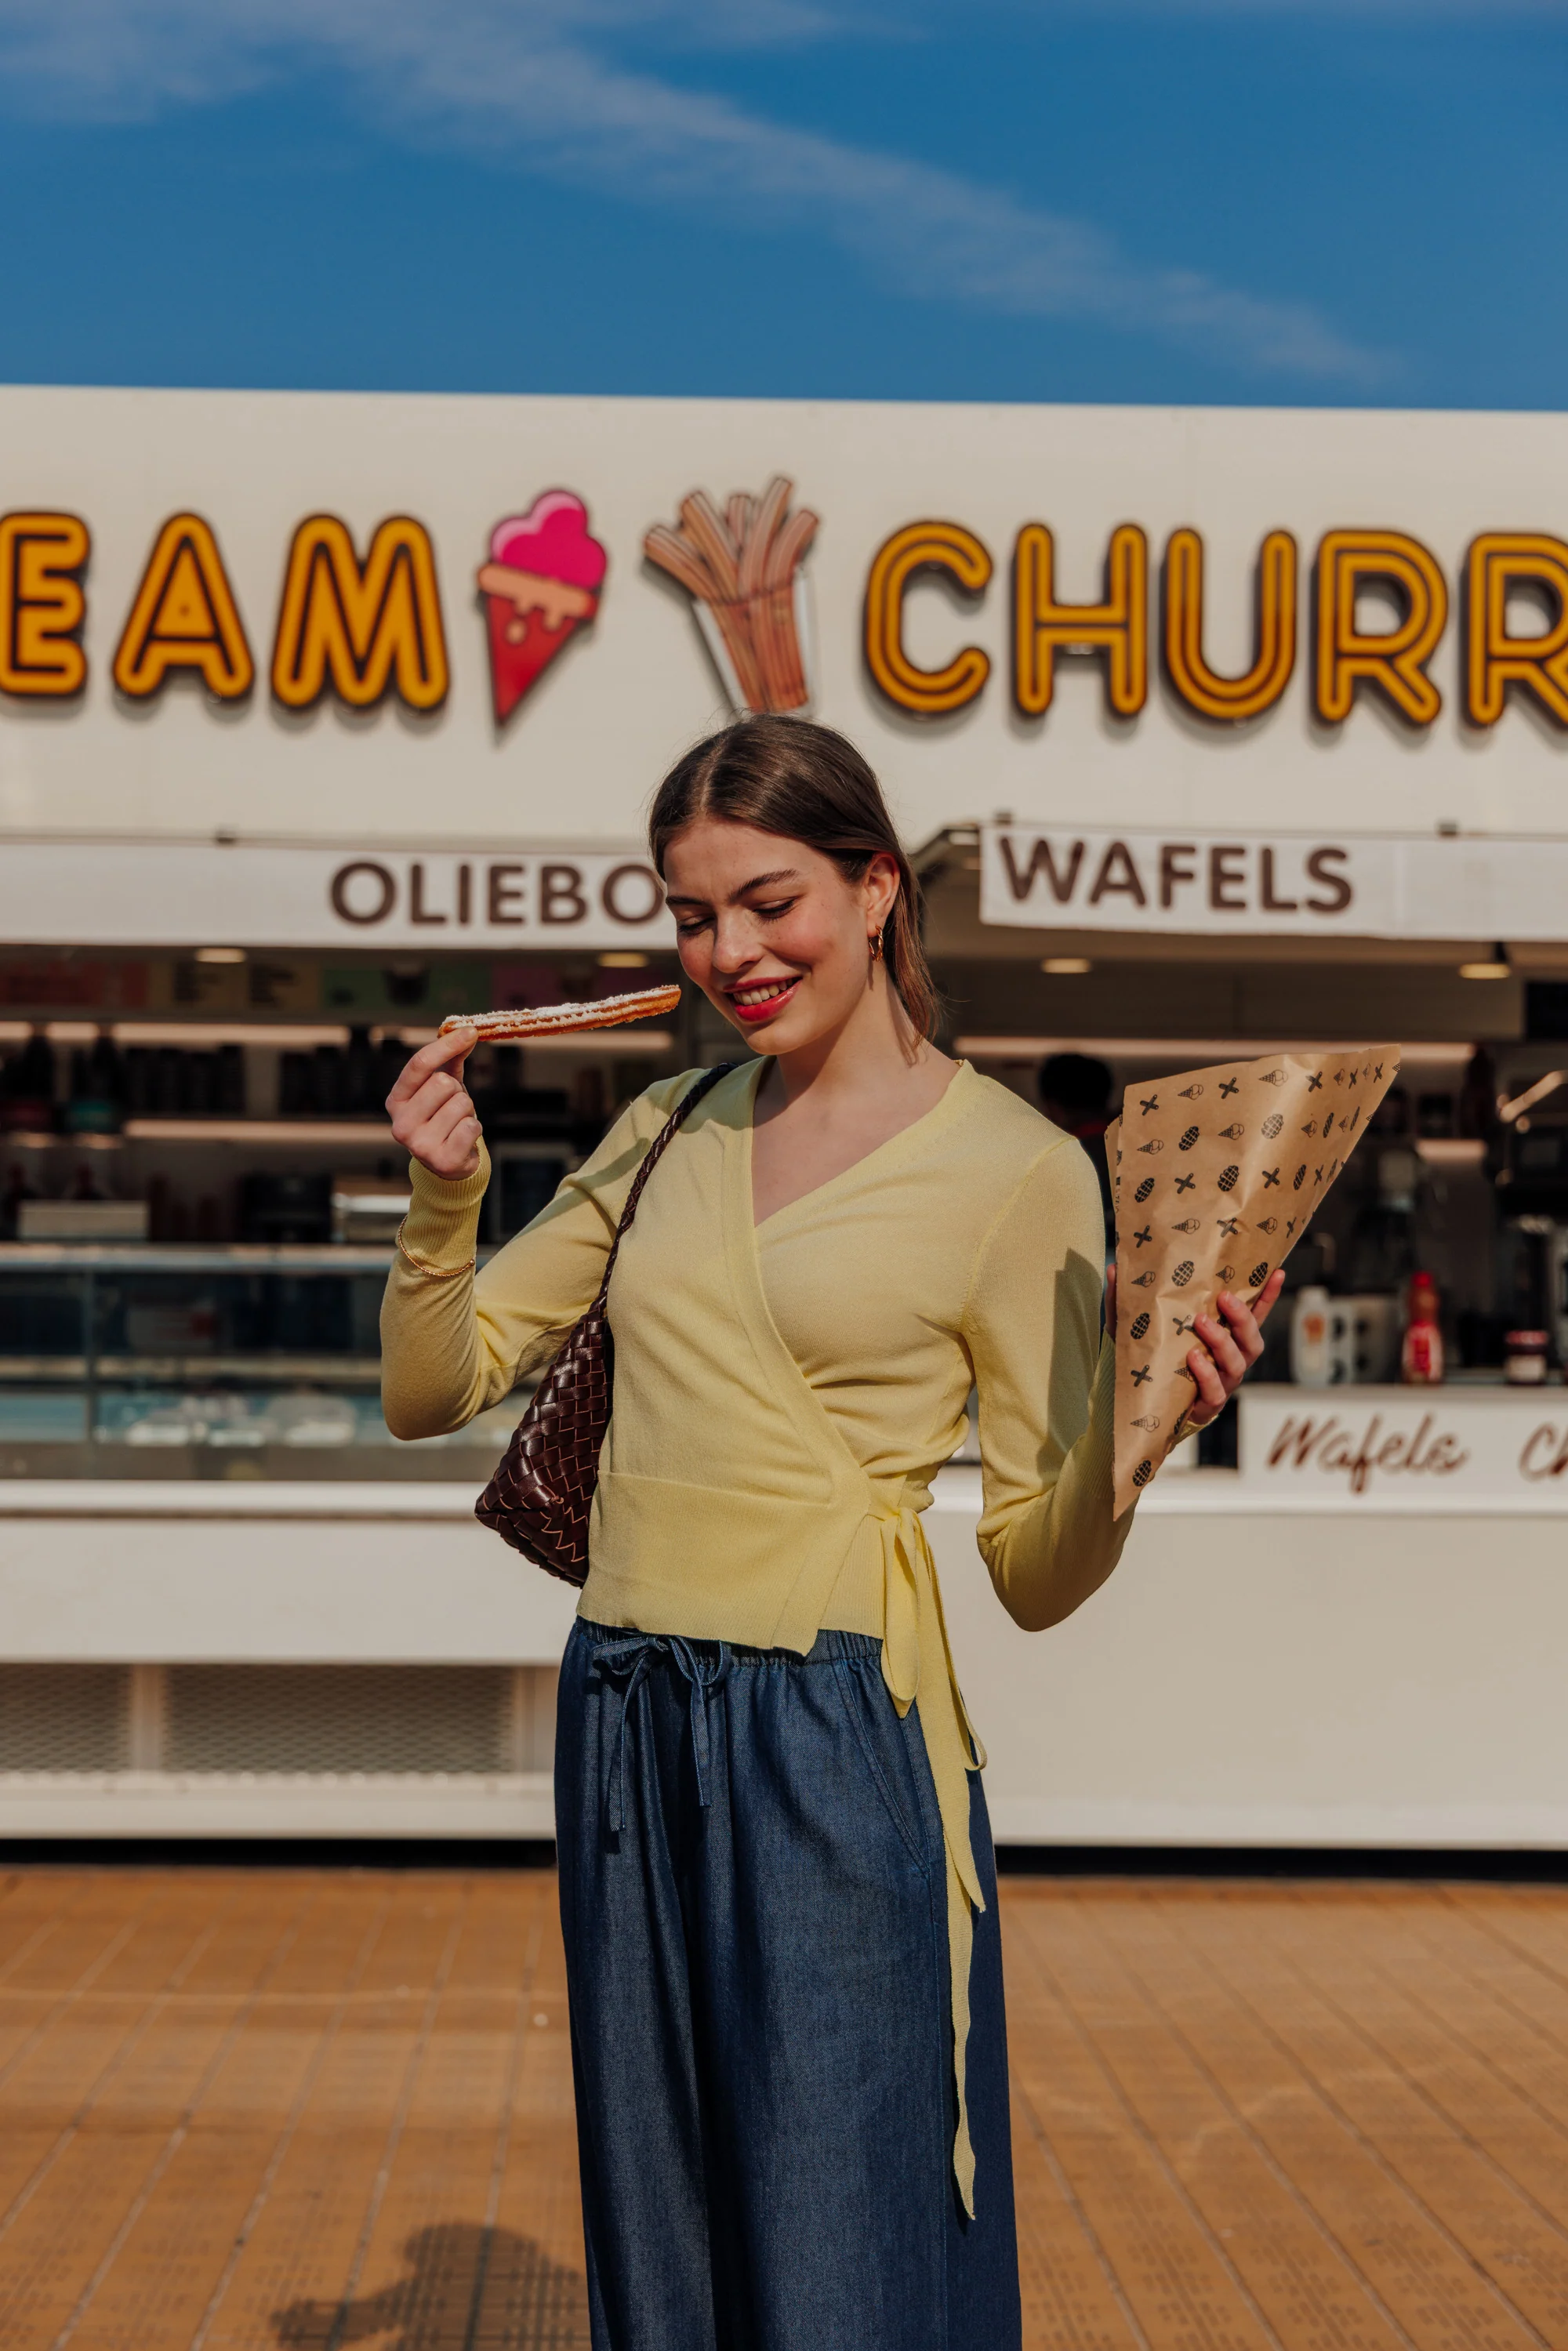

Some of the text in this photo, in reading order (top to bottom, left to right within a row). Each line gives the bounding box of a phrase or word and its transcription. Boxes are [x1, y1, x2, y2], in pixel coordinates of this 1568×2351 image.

[0, 511, 1568, 726] EAM CHURR
[329, 860, 666, 927] OLIEBO
[998, 835, 1355, 914] WAFELS
[1266, 1413, 1468, 1497] Wafels
